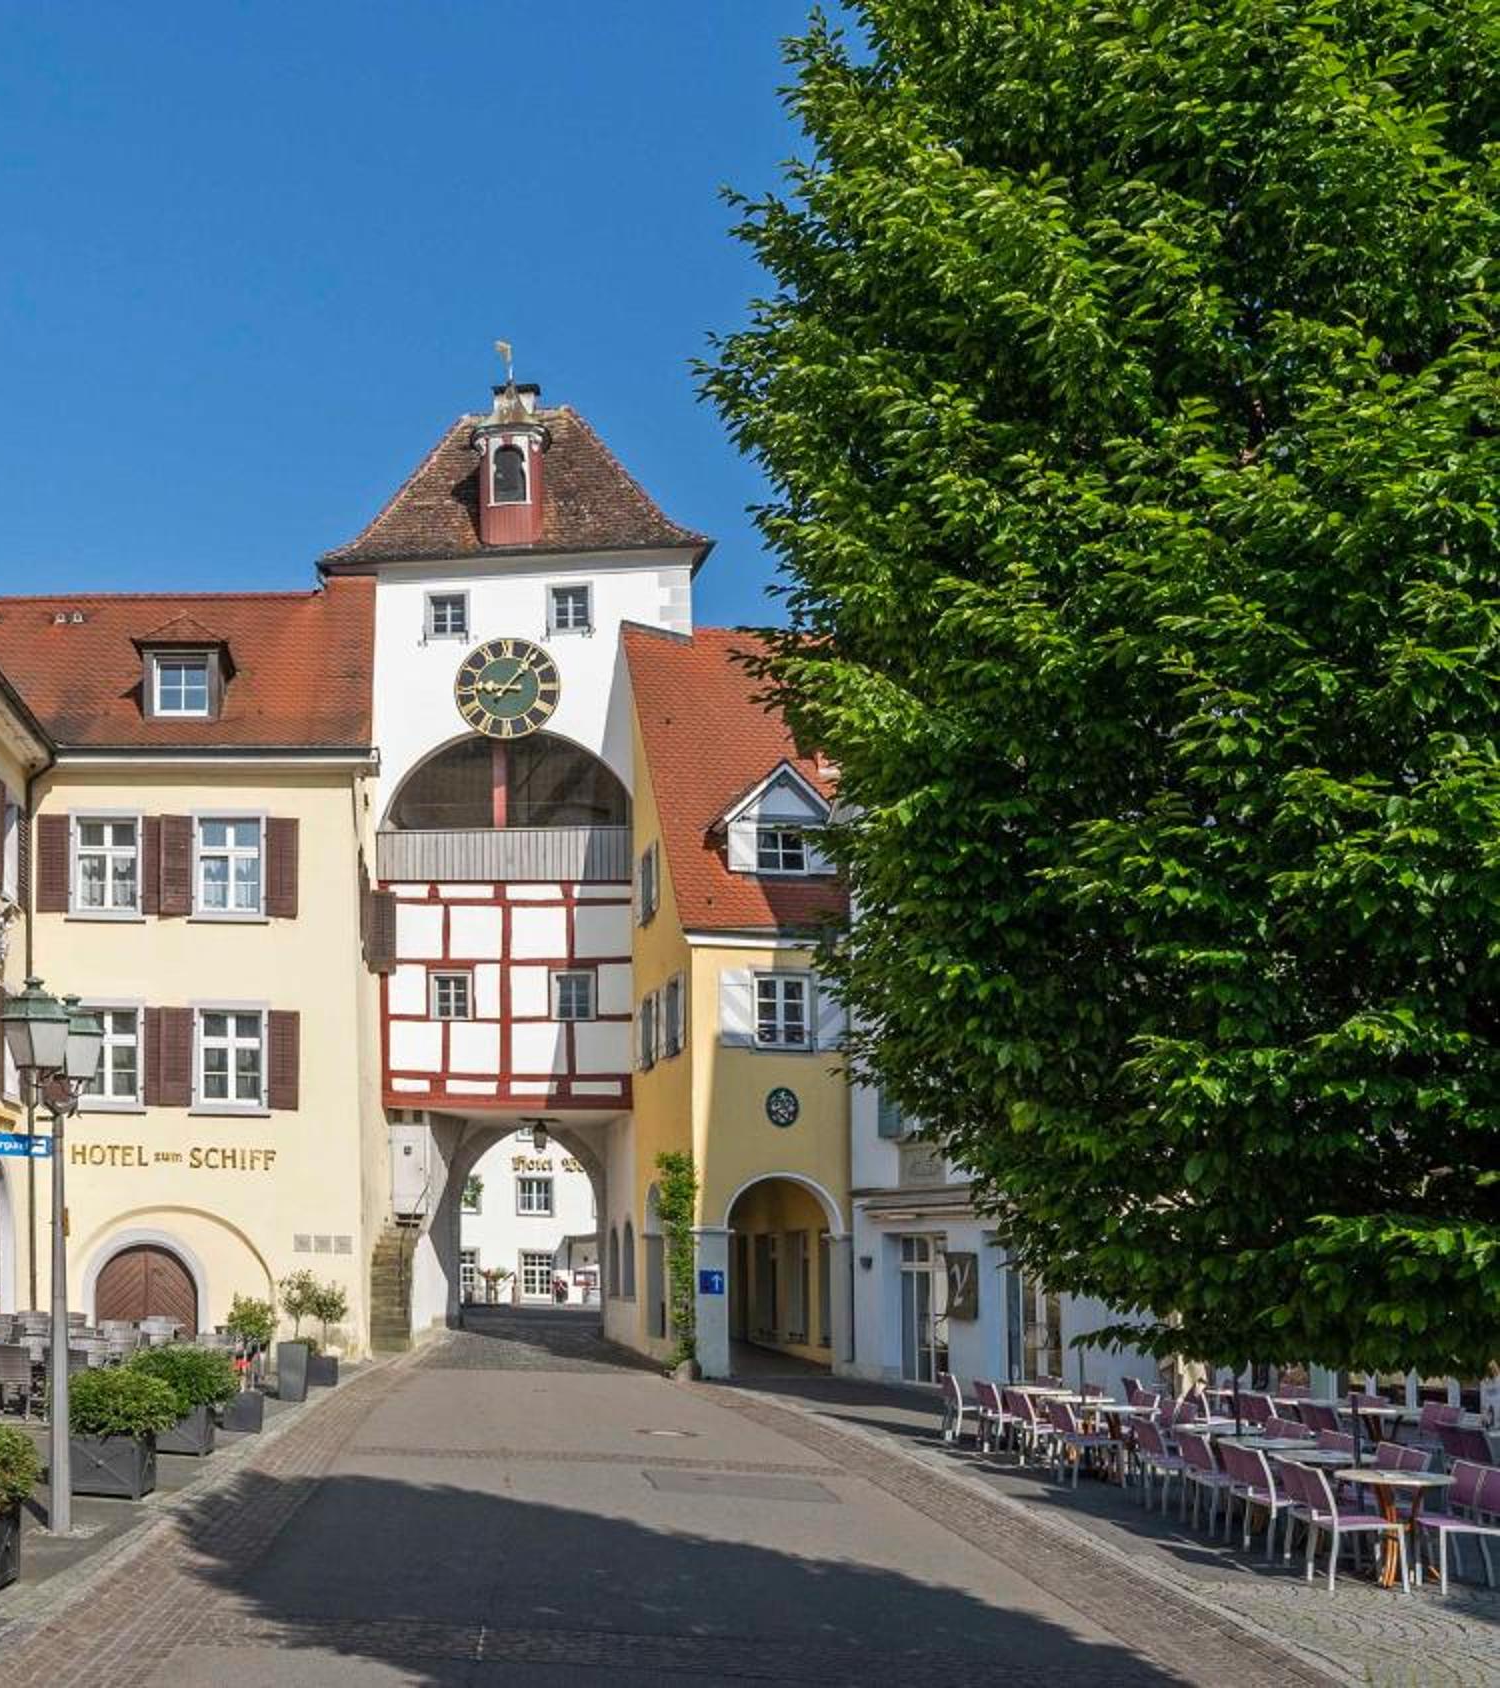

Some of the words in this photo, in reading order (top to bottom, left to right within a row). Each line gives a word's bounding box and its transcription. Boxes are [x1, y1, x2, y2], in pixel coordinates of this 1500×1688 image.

[70, 1143, 149, 1167] HOTEL
[153, 1151, 183, 1163] zum
[189, 1147, 277, 1171] SCHIFF
